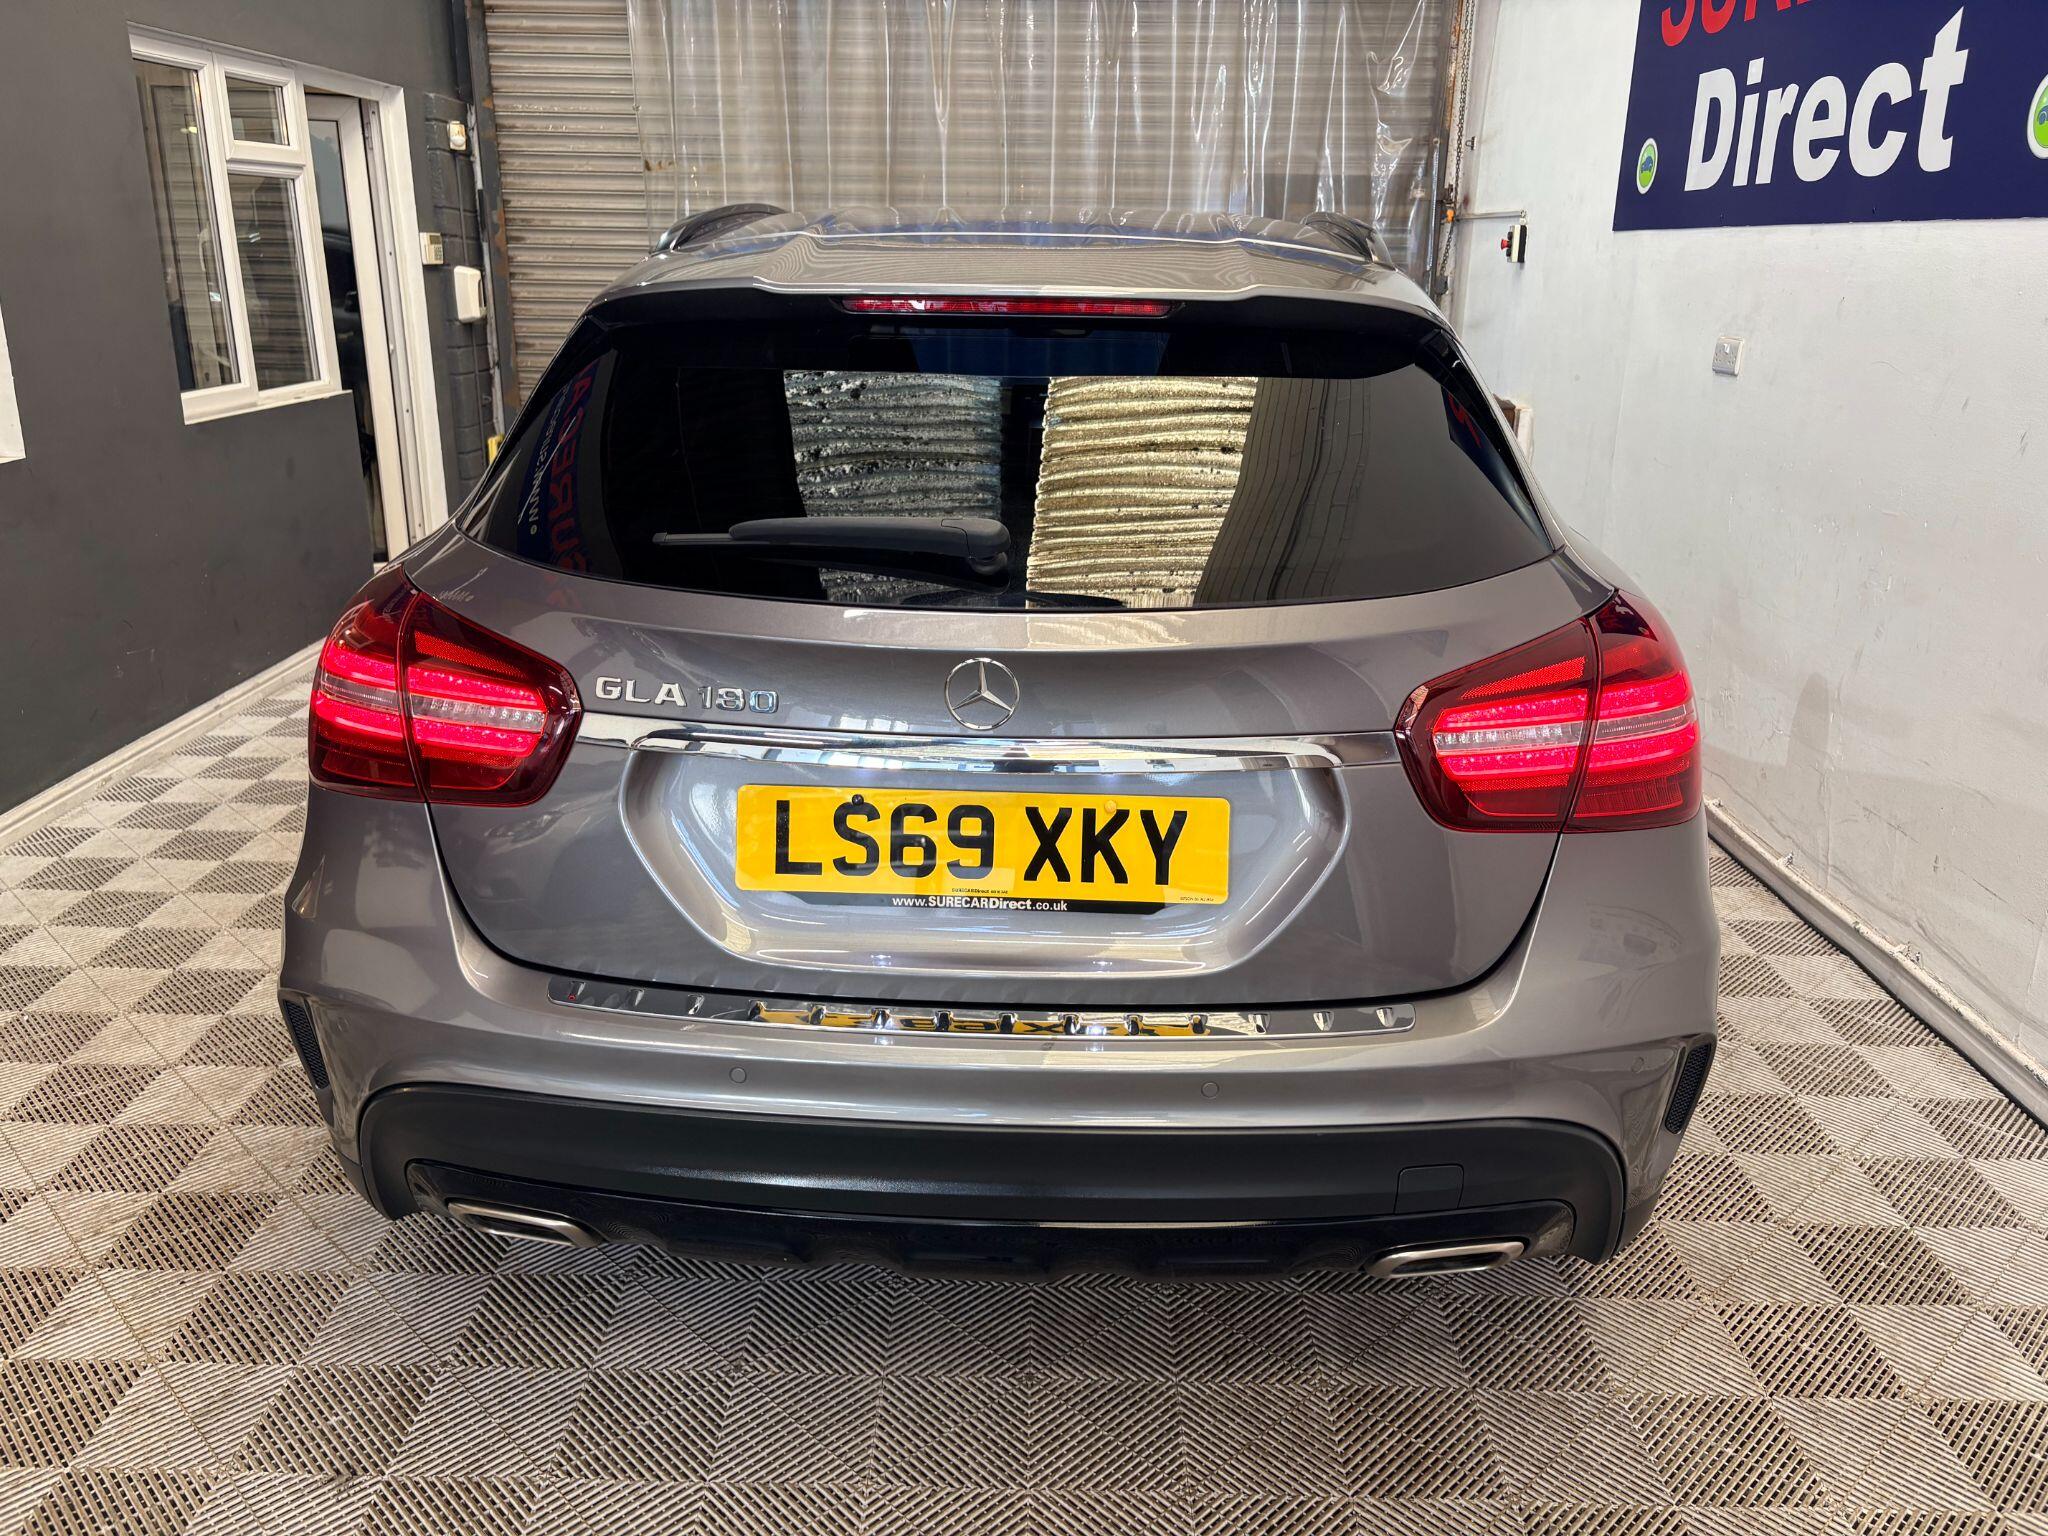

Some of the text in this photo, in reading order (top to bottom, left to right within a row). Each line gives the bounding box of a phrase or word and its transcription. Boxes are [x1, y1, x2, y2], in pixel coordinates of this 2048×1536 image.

[1684, 6, 1969, 191] Direct
[595, 676, 778, 713] GLA 180
[774, 797, 1188, 886] LS69 XKY
[892, 895, 1068, 912] www.SURECARDirect.co.uk
